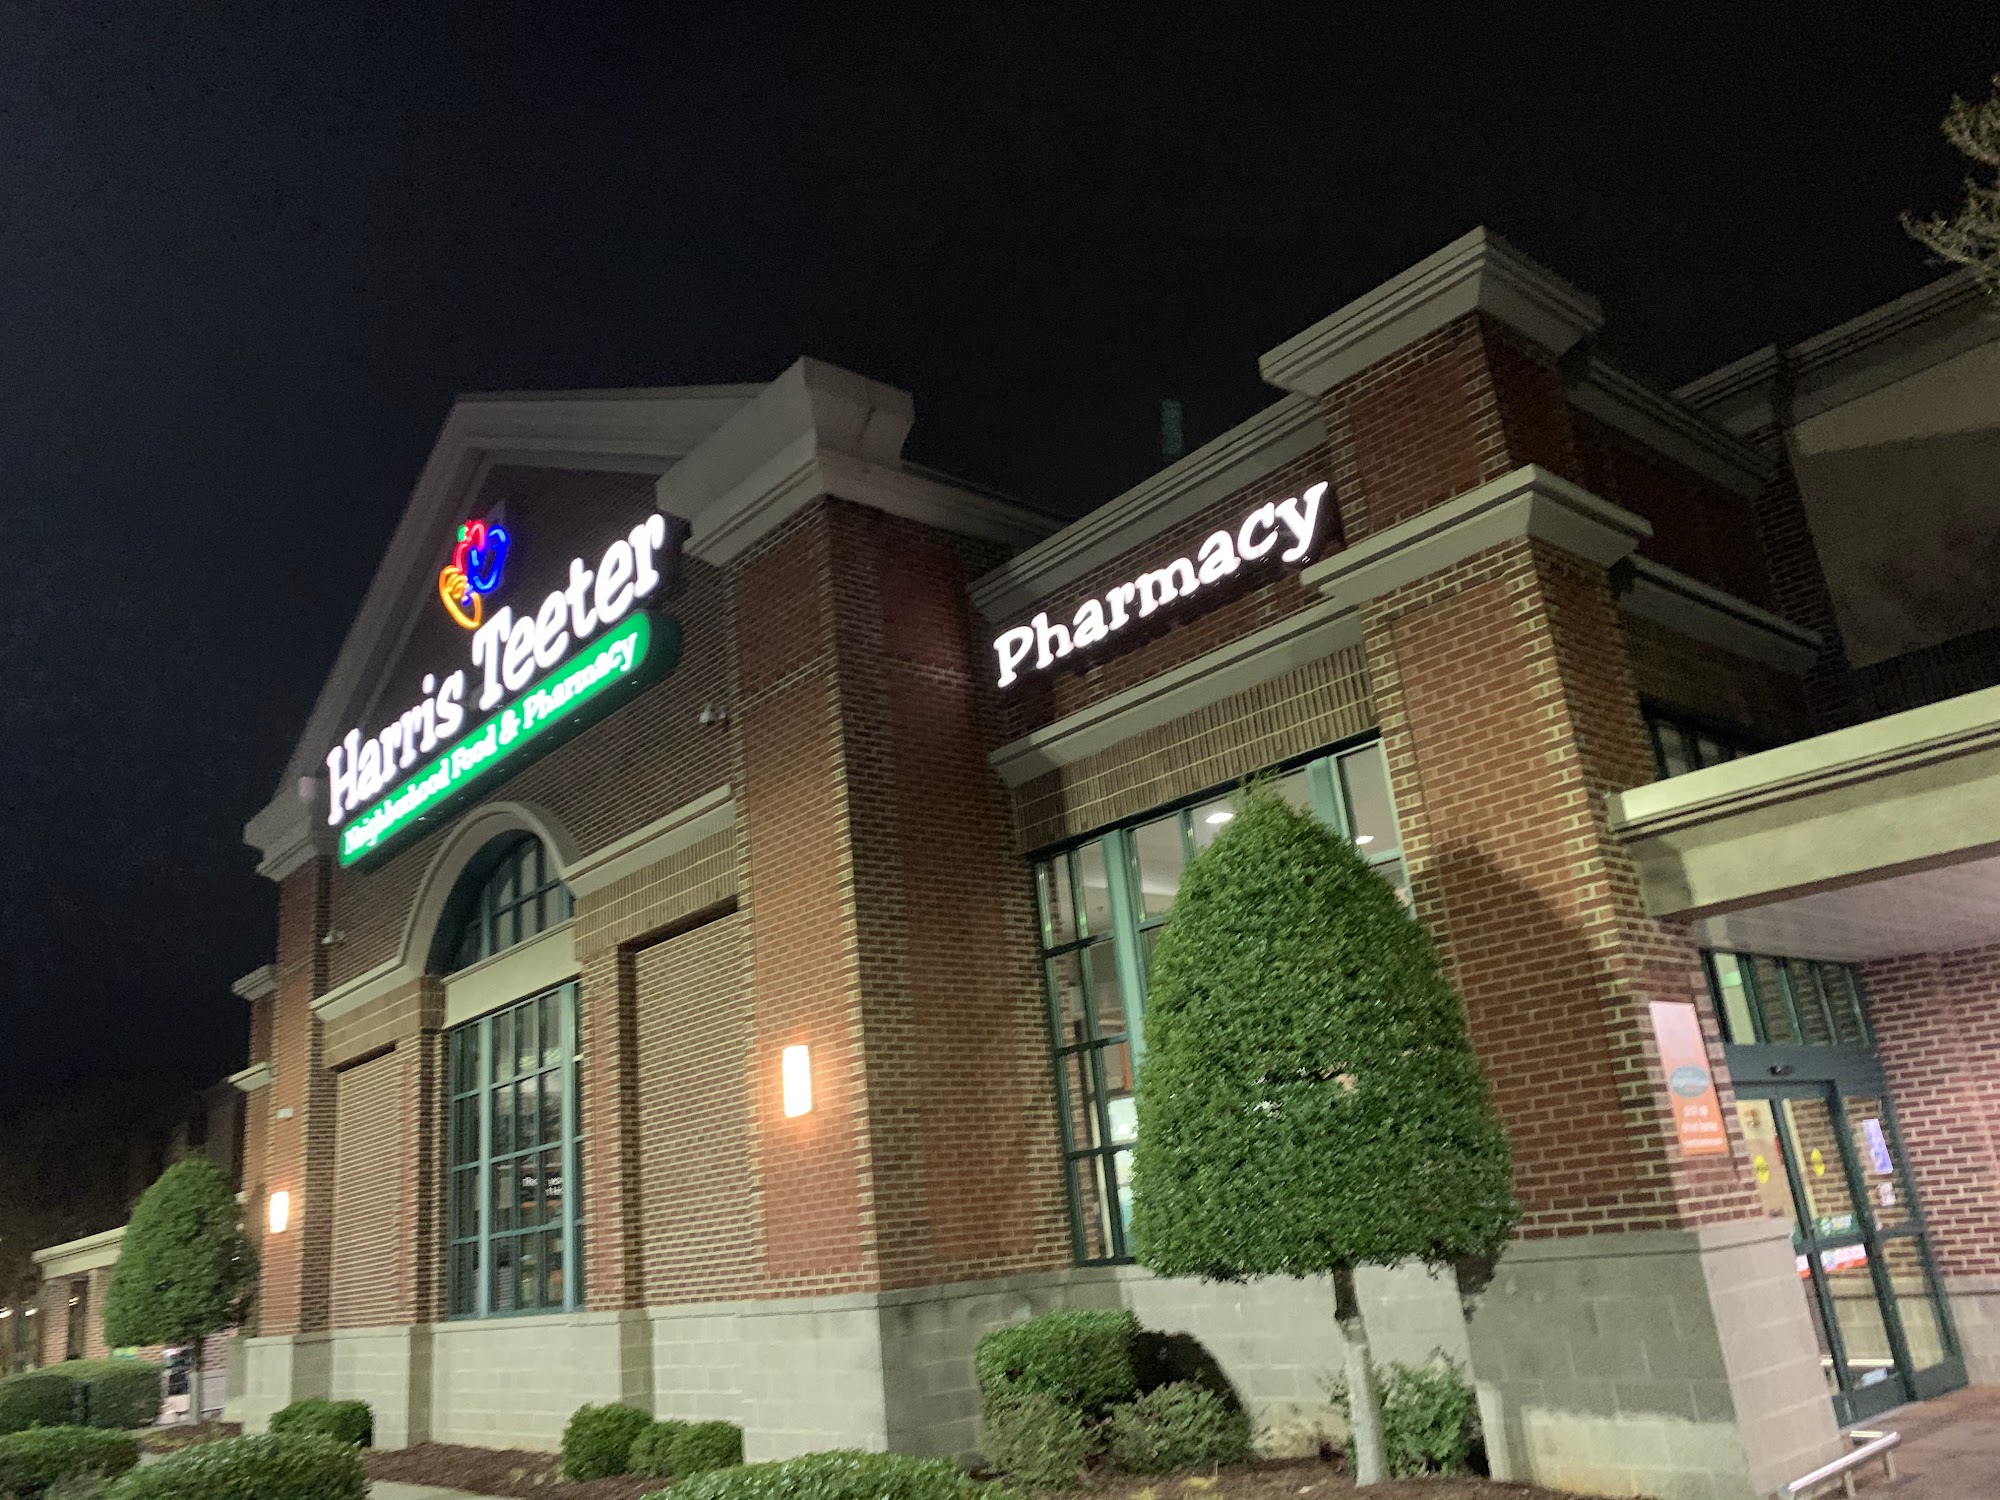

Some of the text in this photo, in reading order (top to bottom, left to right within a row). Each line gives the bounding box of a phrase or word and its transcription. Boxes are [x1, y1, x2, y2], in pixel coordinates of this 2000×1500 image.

[325, 513, 665, 826] Harris Teeter
[992, 481, 1329, 688] Pharmacy
[343, 631, 638, 855] Neighborhood Food & Pharmacy
